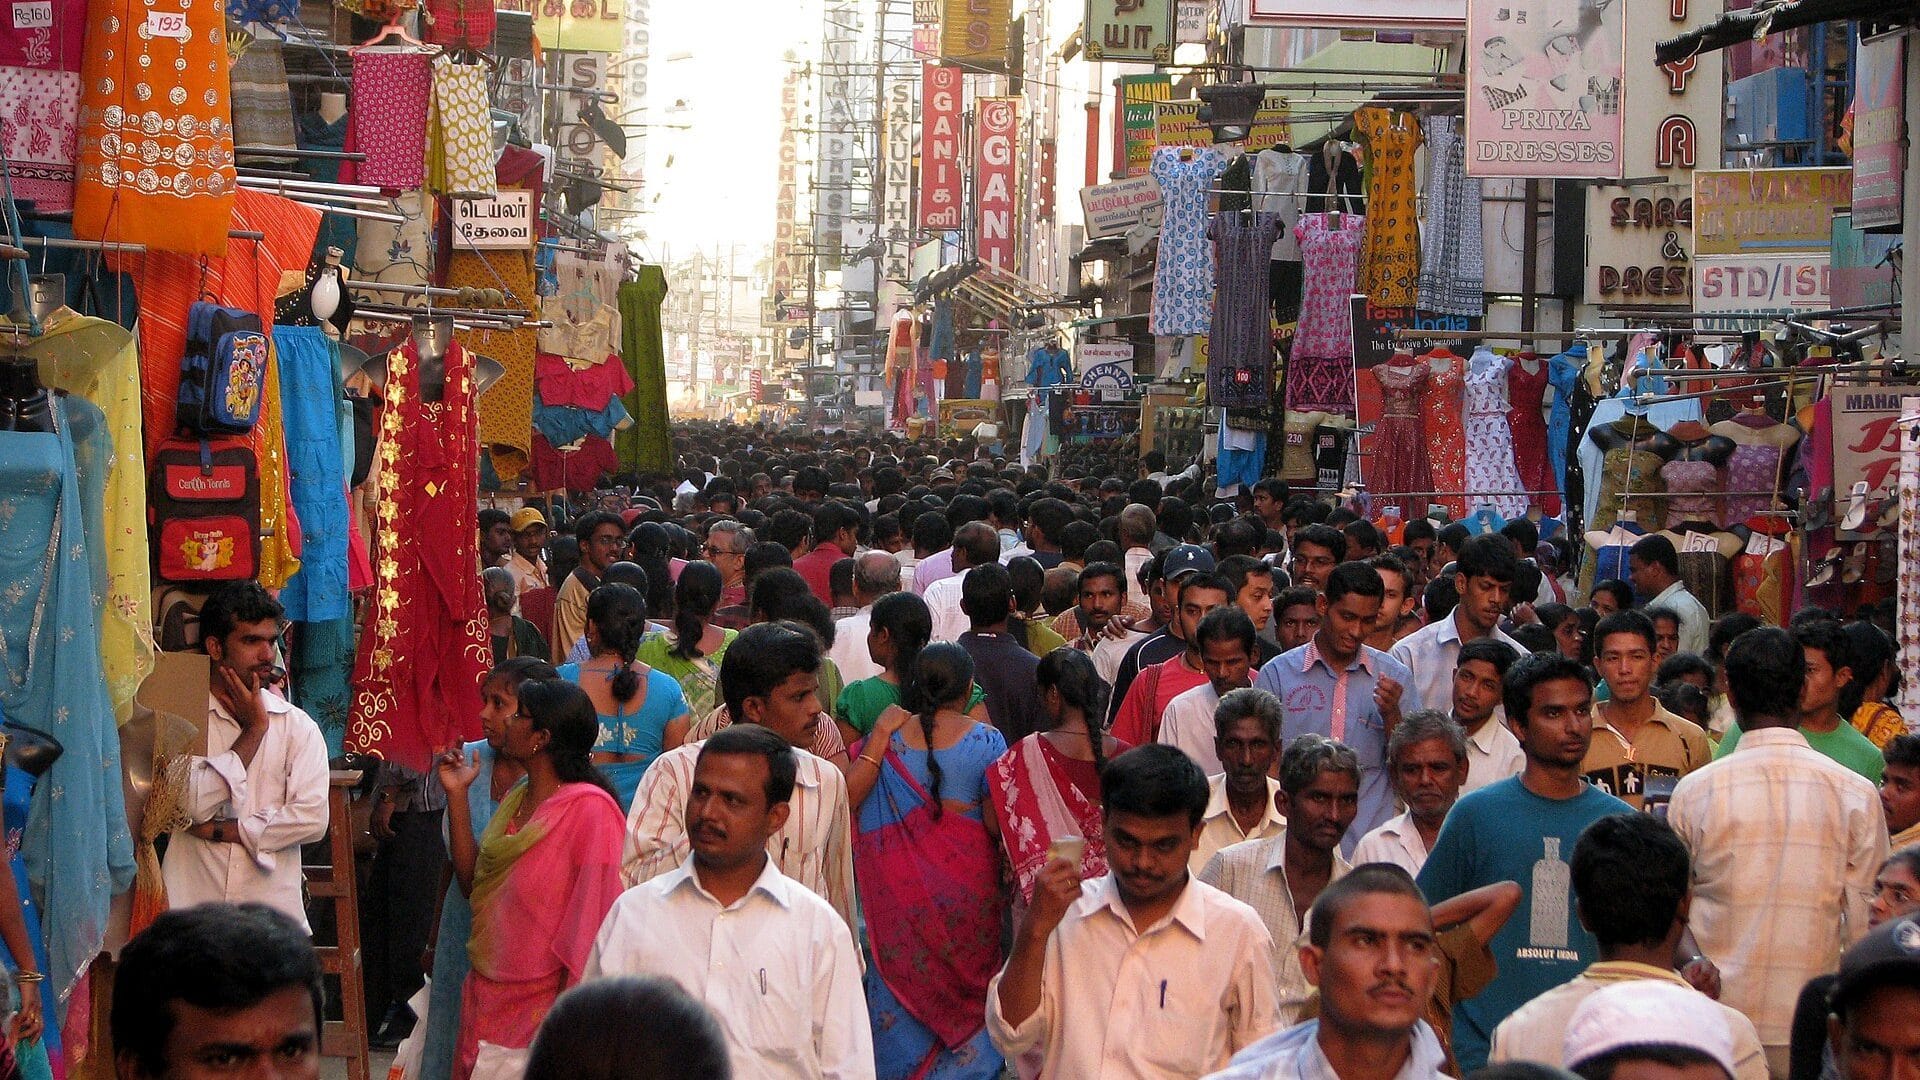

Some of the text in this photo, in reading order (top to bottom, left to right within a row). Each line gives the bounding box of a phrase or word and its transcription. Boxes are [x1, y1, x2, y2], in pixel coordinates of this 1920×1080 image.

[157, 16, 184, 32] 195
[1126, 82, 1171, 105] ANAND
[1502, 109, 1591, 130] PRIYA
[1477, 141, 1615, 163] DRESSES
[887, 84, 909, 279] SAKUNTHALA
[983, 135, 1011, 276] GANI
[462, 222, 528, 241] தேவை
[1662, 230, 1688, 260] &
[1599, 266, 1692, 295] DRES
[1371, 340, 1385, 350] The
[1083, 365, 1130, 388] CHENNAI
[1846, 392, 1902, 410] MAHA
[1287, 433, 1302, 443] 230
[1516, 947, 1579, 961] ABSOLUT INDIA
